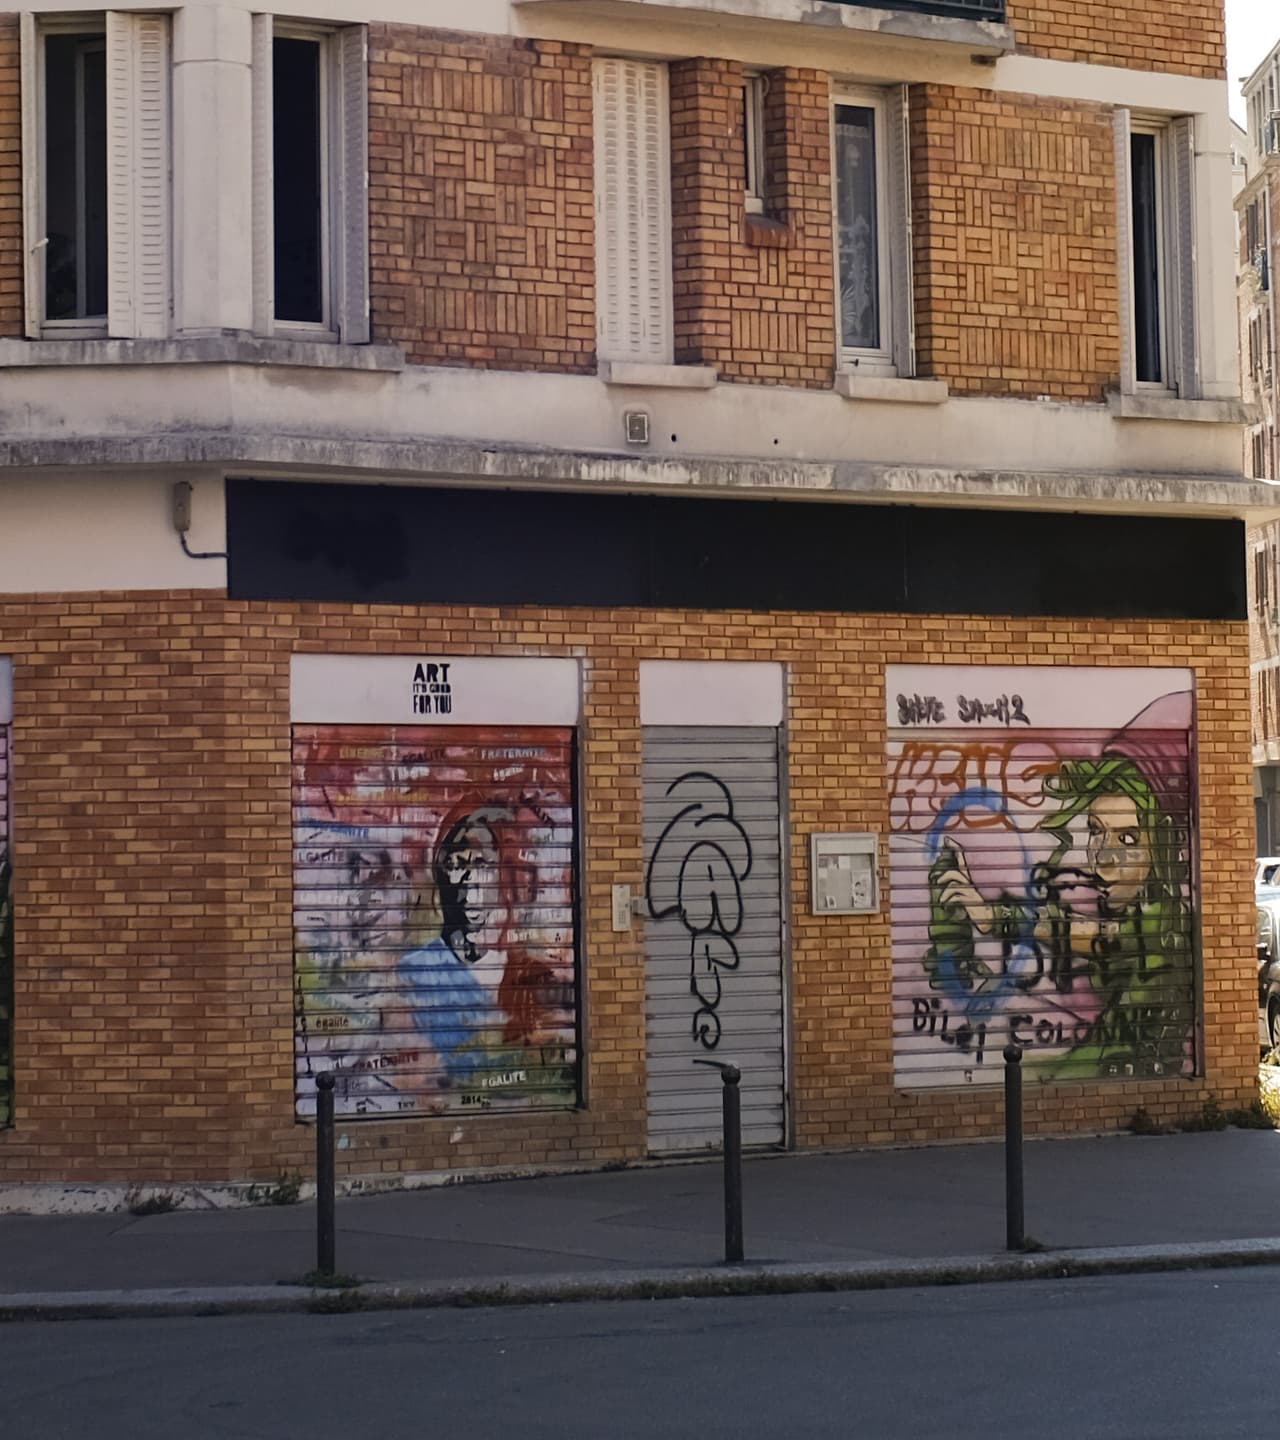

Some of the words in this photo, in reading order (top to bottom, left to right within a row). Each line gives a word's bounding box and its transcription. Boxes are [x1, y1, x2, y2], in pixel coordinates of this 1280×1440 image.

[413, 663, 451, 683] ART
[413, 694, 431, 714] FOR
[433, 694, 452, 714] YOU
